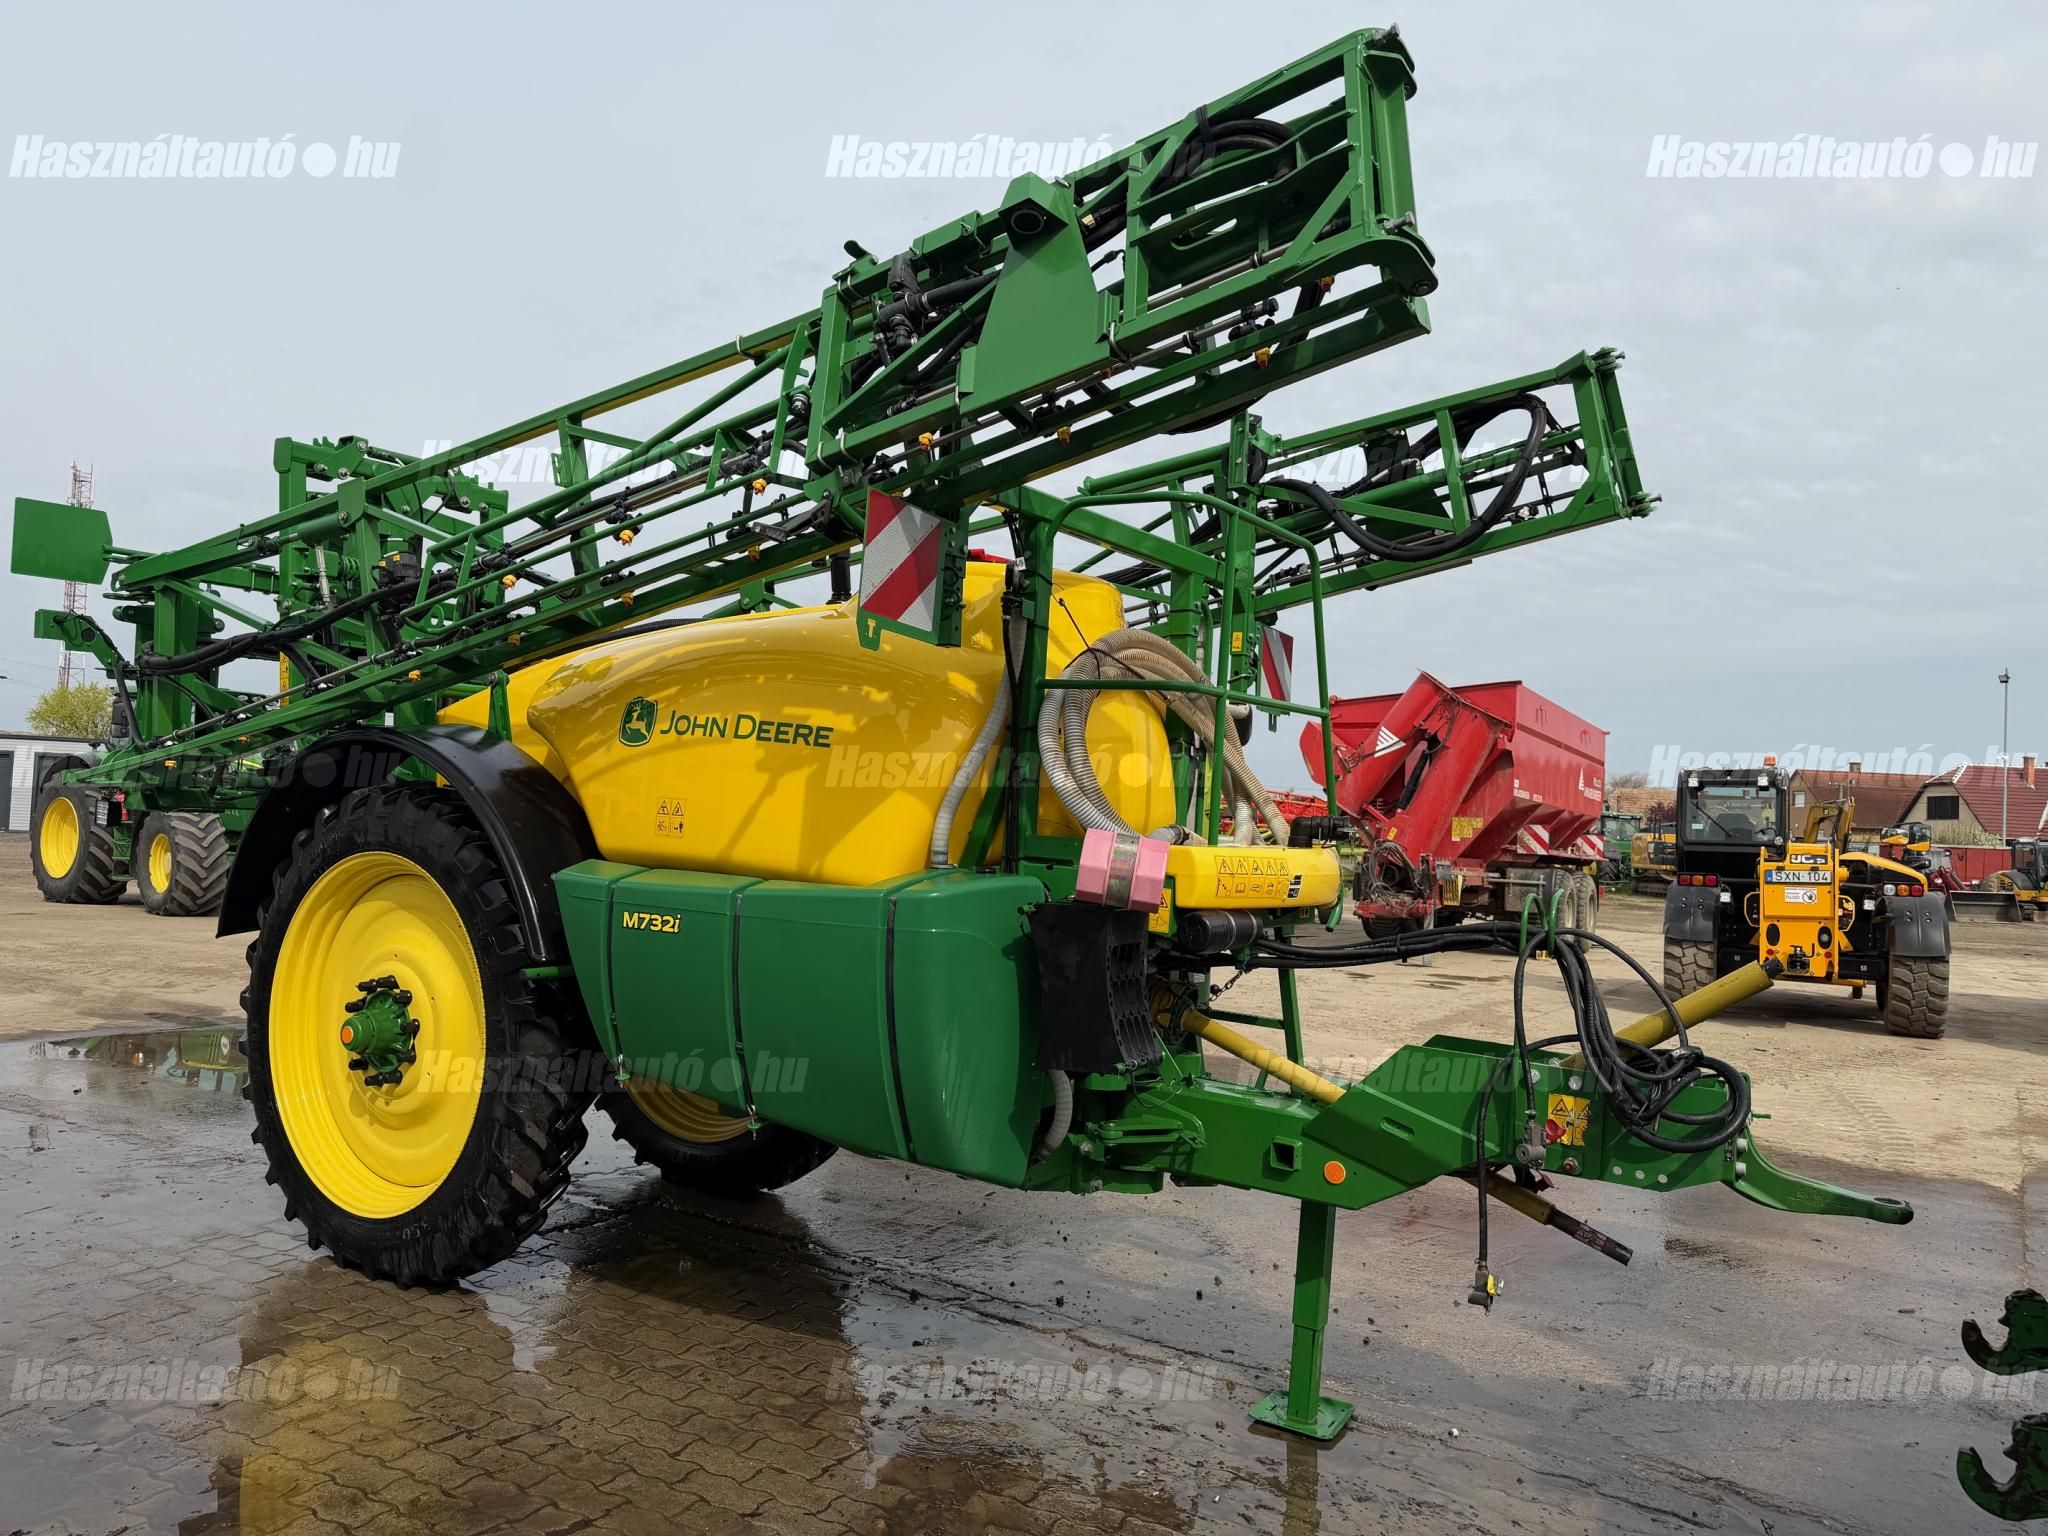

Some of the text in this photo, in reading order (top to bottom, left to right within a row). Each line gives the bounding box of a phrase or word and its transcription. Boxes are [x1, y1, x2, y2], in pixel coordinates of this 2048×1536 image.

[659, 709, 834, 748] JOHN DEERE
[1775, 871, 1828, 881] SXN-104
[623, 911, 681, 933] M732i
